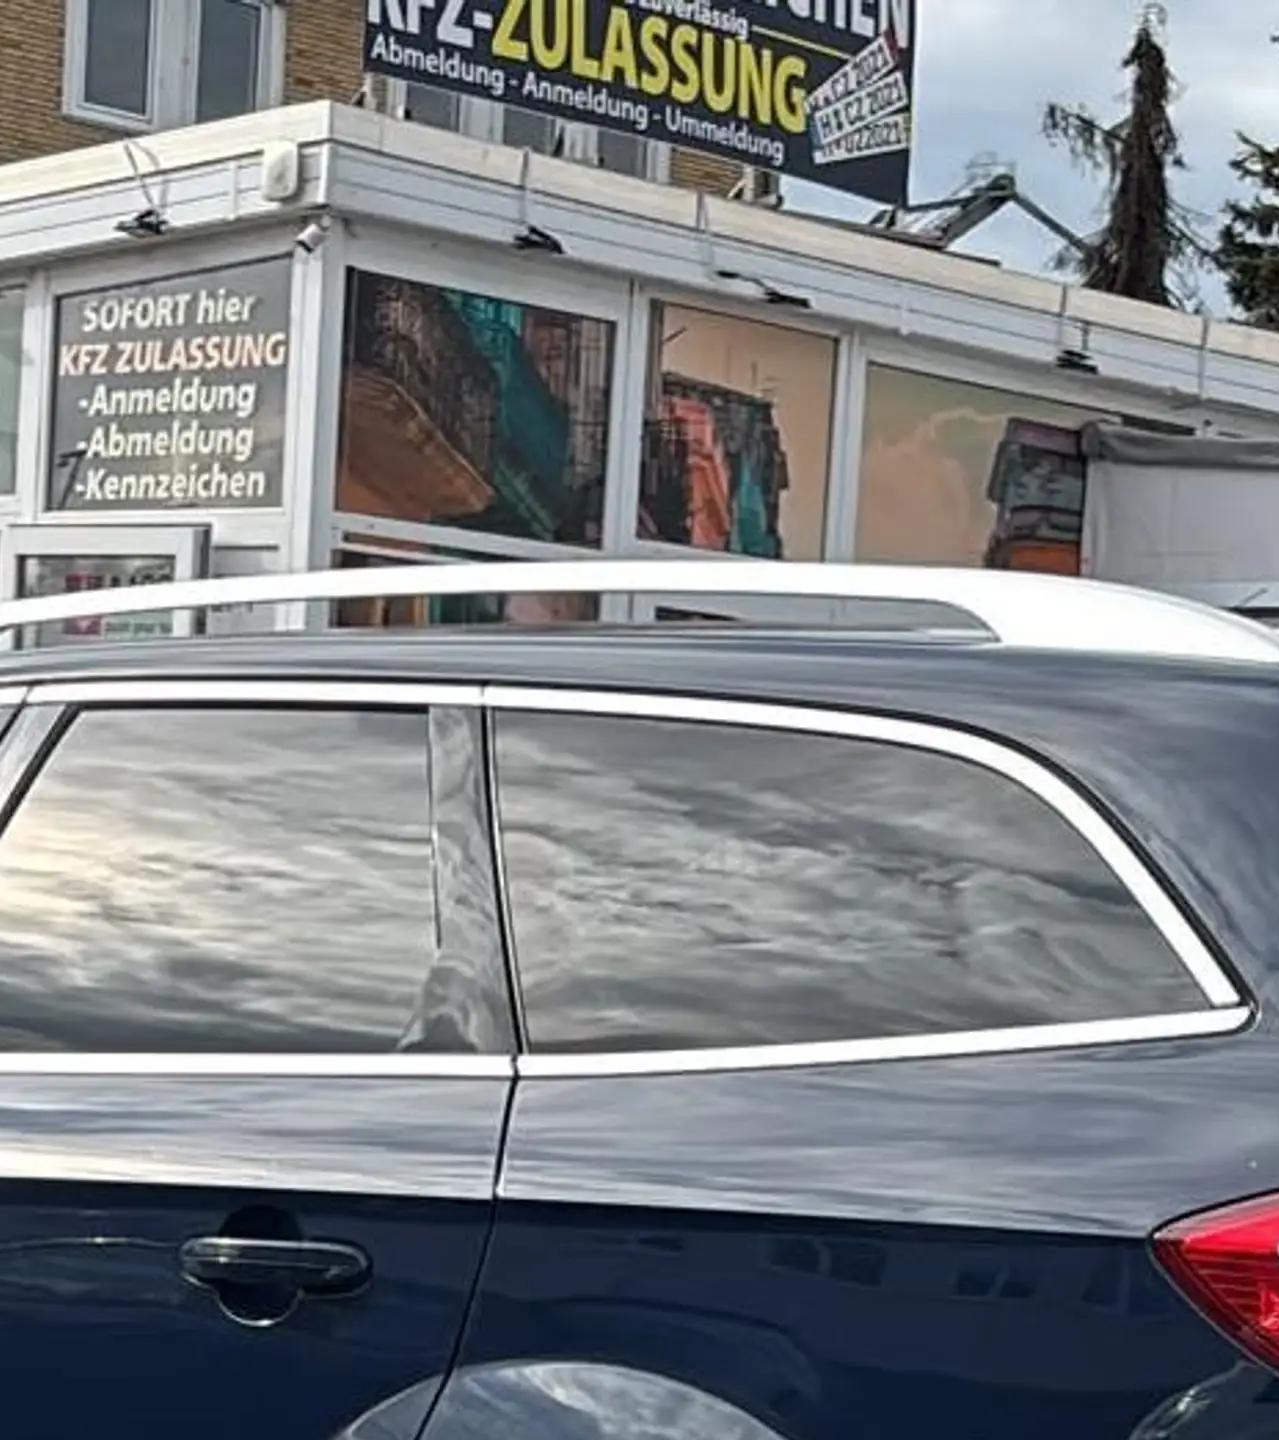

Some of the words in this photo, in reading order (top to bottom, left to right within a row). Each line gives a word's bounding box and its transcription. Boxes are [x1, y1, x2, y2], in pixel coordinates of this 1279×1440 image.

[371, 33, 505, 96] Abmeldung
[522, 71, 649, 131] Anmeldung
[665, 105, 785, 166] Ummeldung
[81, 293, 192, 332] SOFORT
[196, 289, 257, 325] hier
[59, 342, 110, 377] KFZ
[113, 331, 288, 375] ZULASSUNG
[78, 377, 258, 418] -Anmeldung
[76, 419, 256, 462] -Abmeldung
[75, 461, 267, 501] -Kennzeichen
